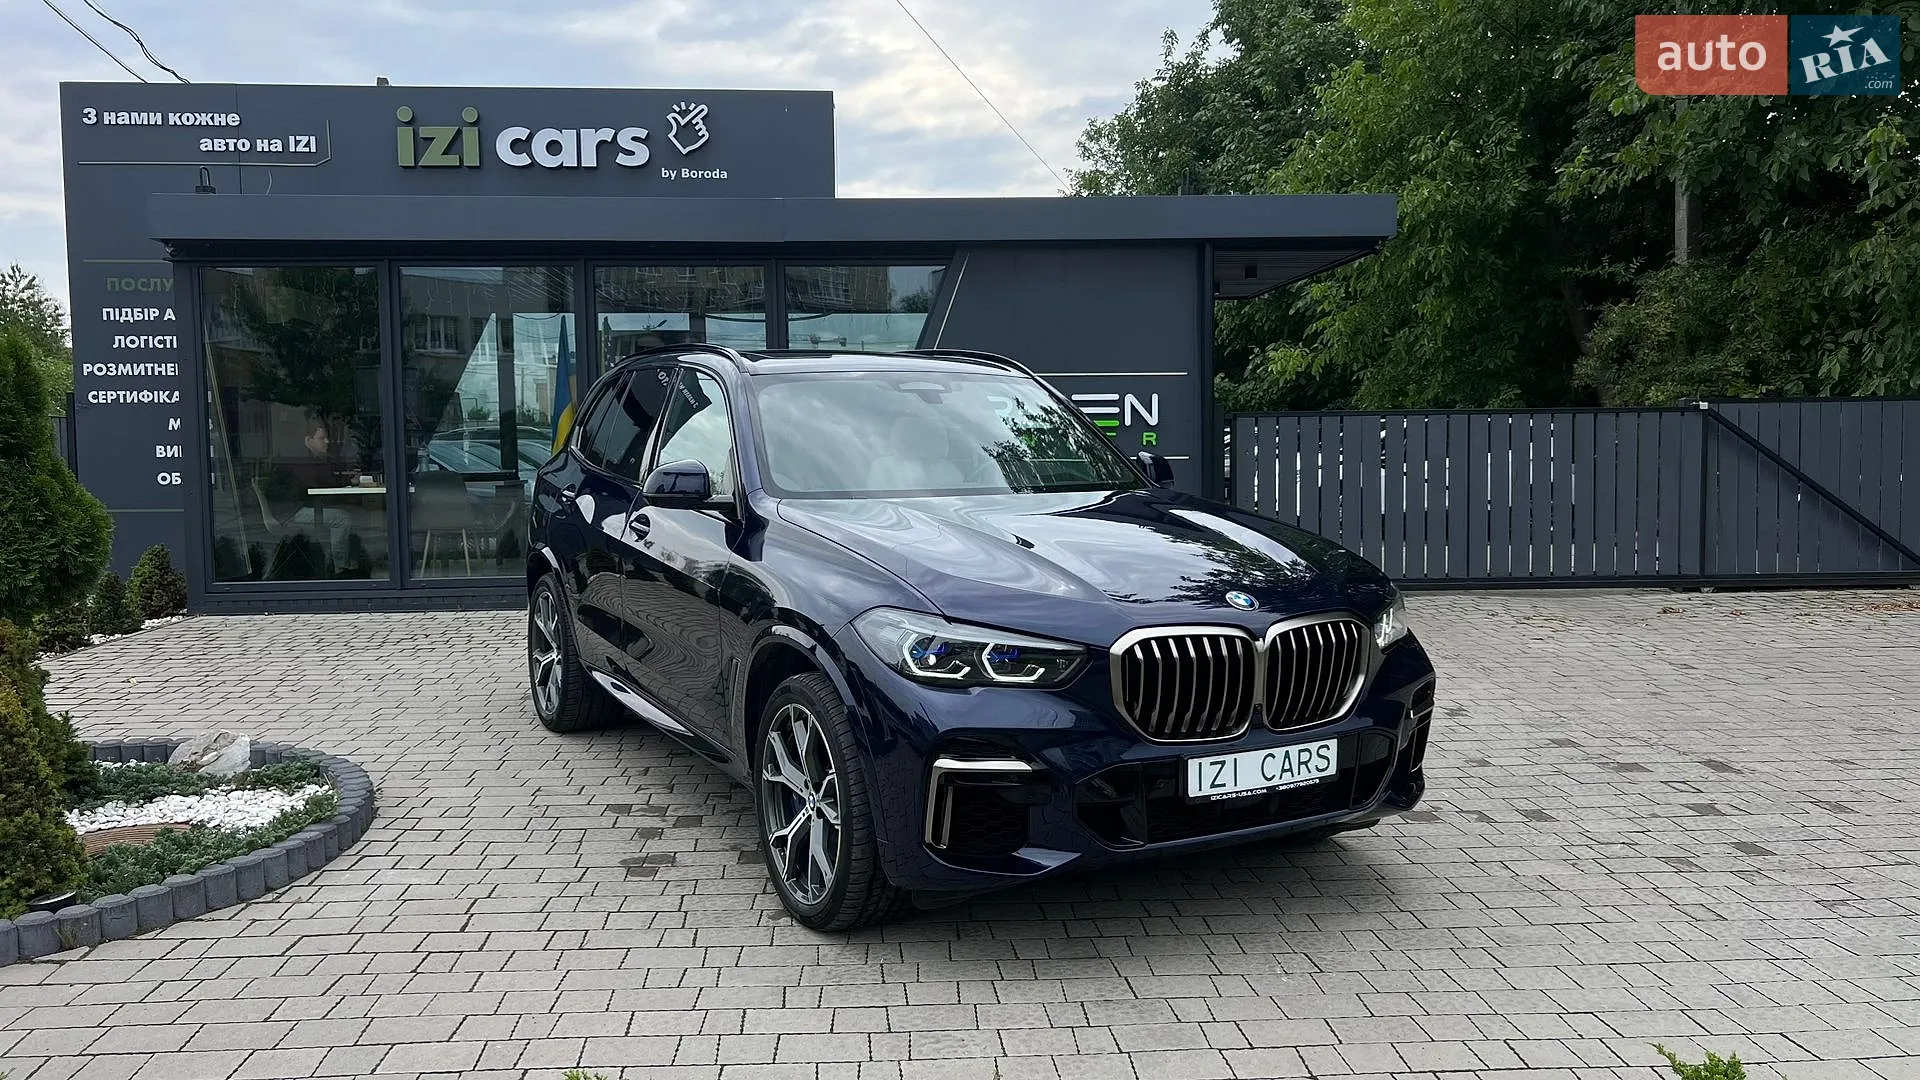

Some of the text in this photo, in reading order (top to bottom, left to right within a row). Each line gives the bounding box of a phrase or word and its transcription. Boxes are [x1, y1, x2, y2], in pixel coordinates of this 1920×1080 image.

[82, 107, 241, 128] З нами кожне
[199, 135, 317, 153] авто на IZI
[396, 105, 650, 168] izi cars
[661, 167, 728, 181] by Boroda
[102, 308, 160, 323] ПІДБІР
[1197, 743, 1331, 792] IZI CARS
